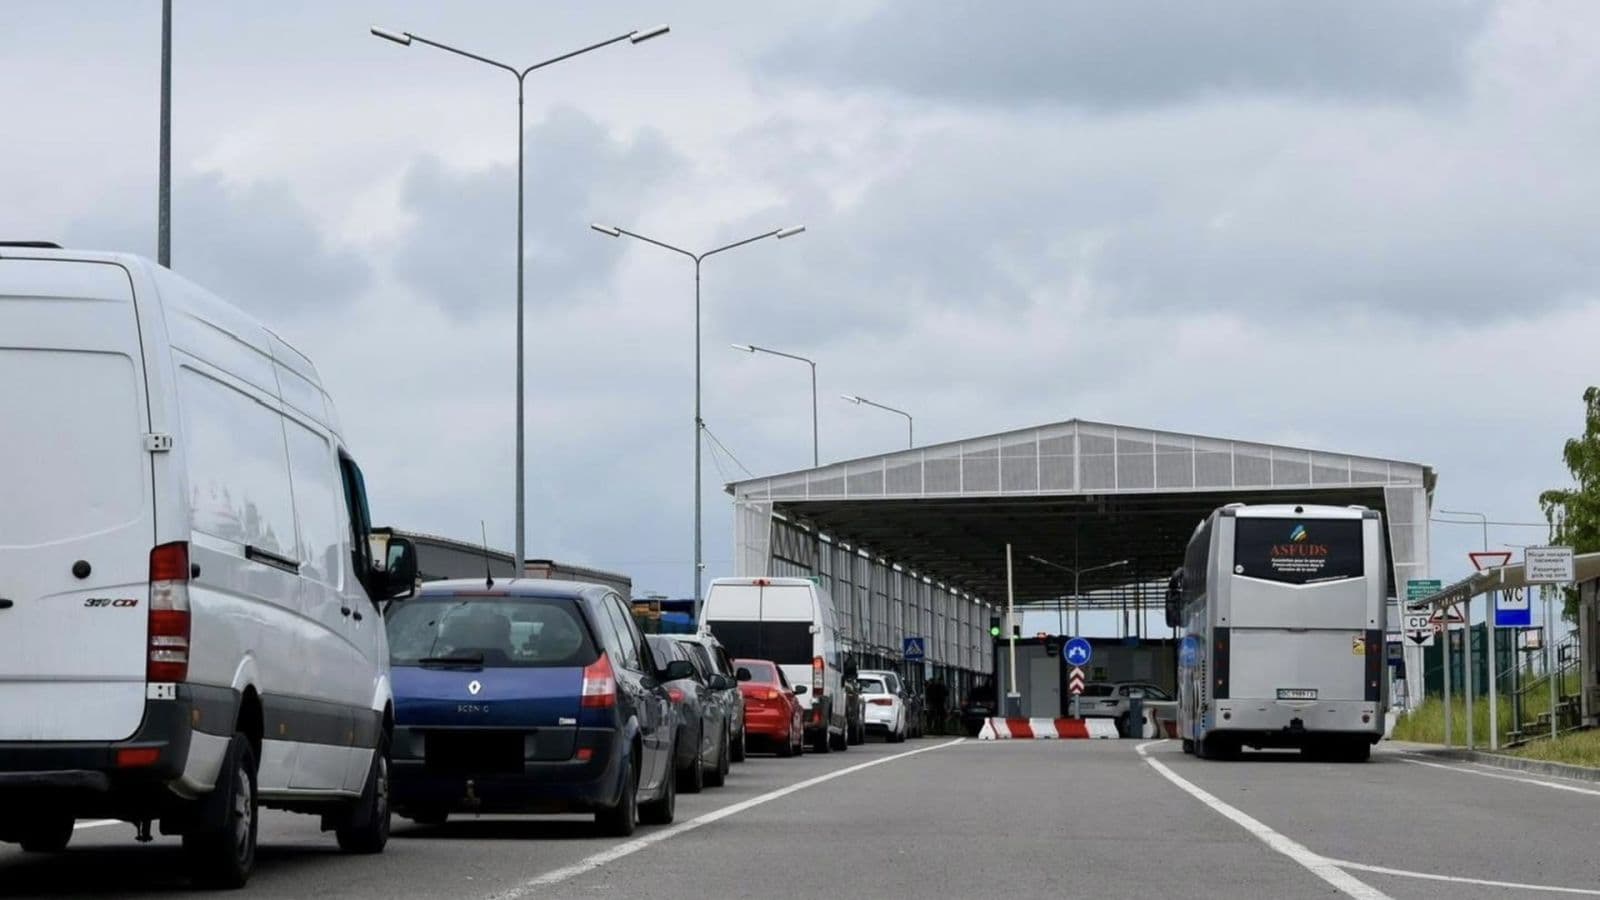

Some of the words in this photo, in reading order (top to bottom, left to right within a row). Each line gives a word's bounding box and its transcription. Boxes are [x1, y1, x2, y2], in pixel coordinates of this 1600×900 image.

[1503, 587, 1524, 602] WC
[1409, 617, 1428, 628] CD
[457, 704, 489, 713] SCENC
